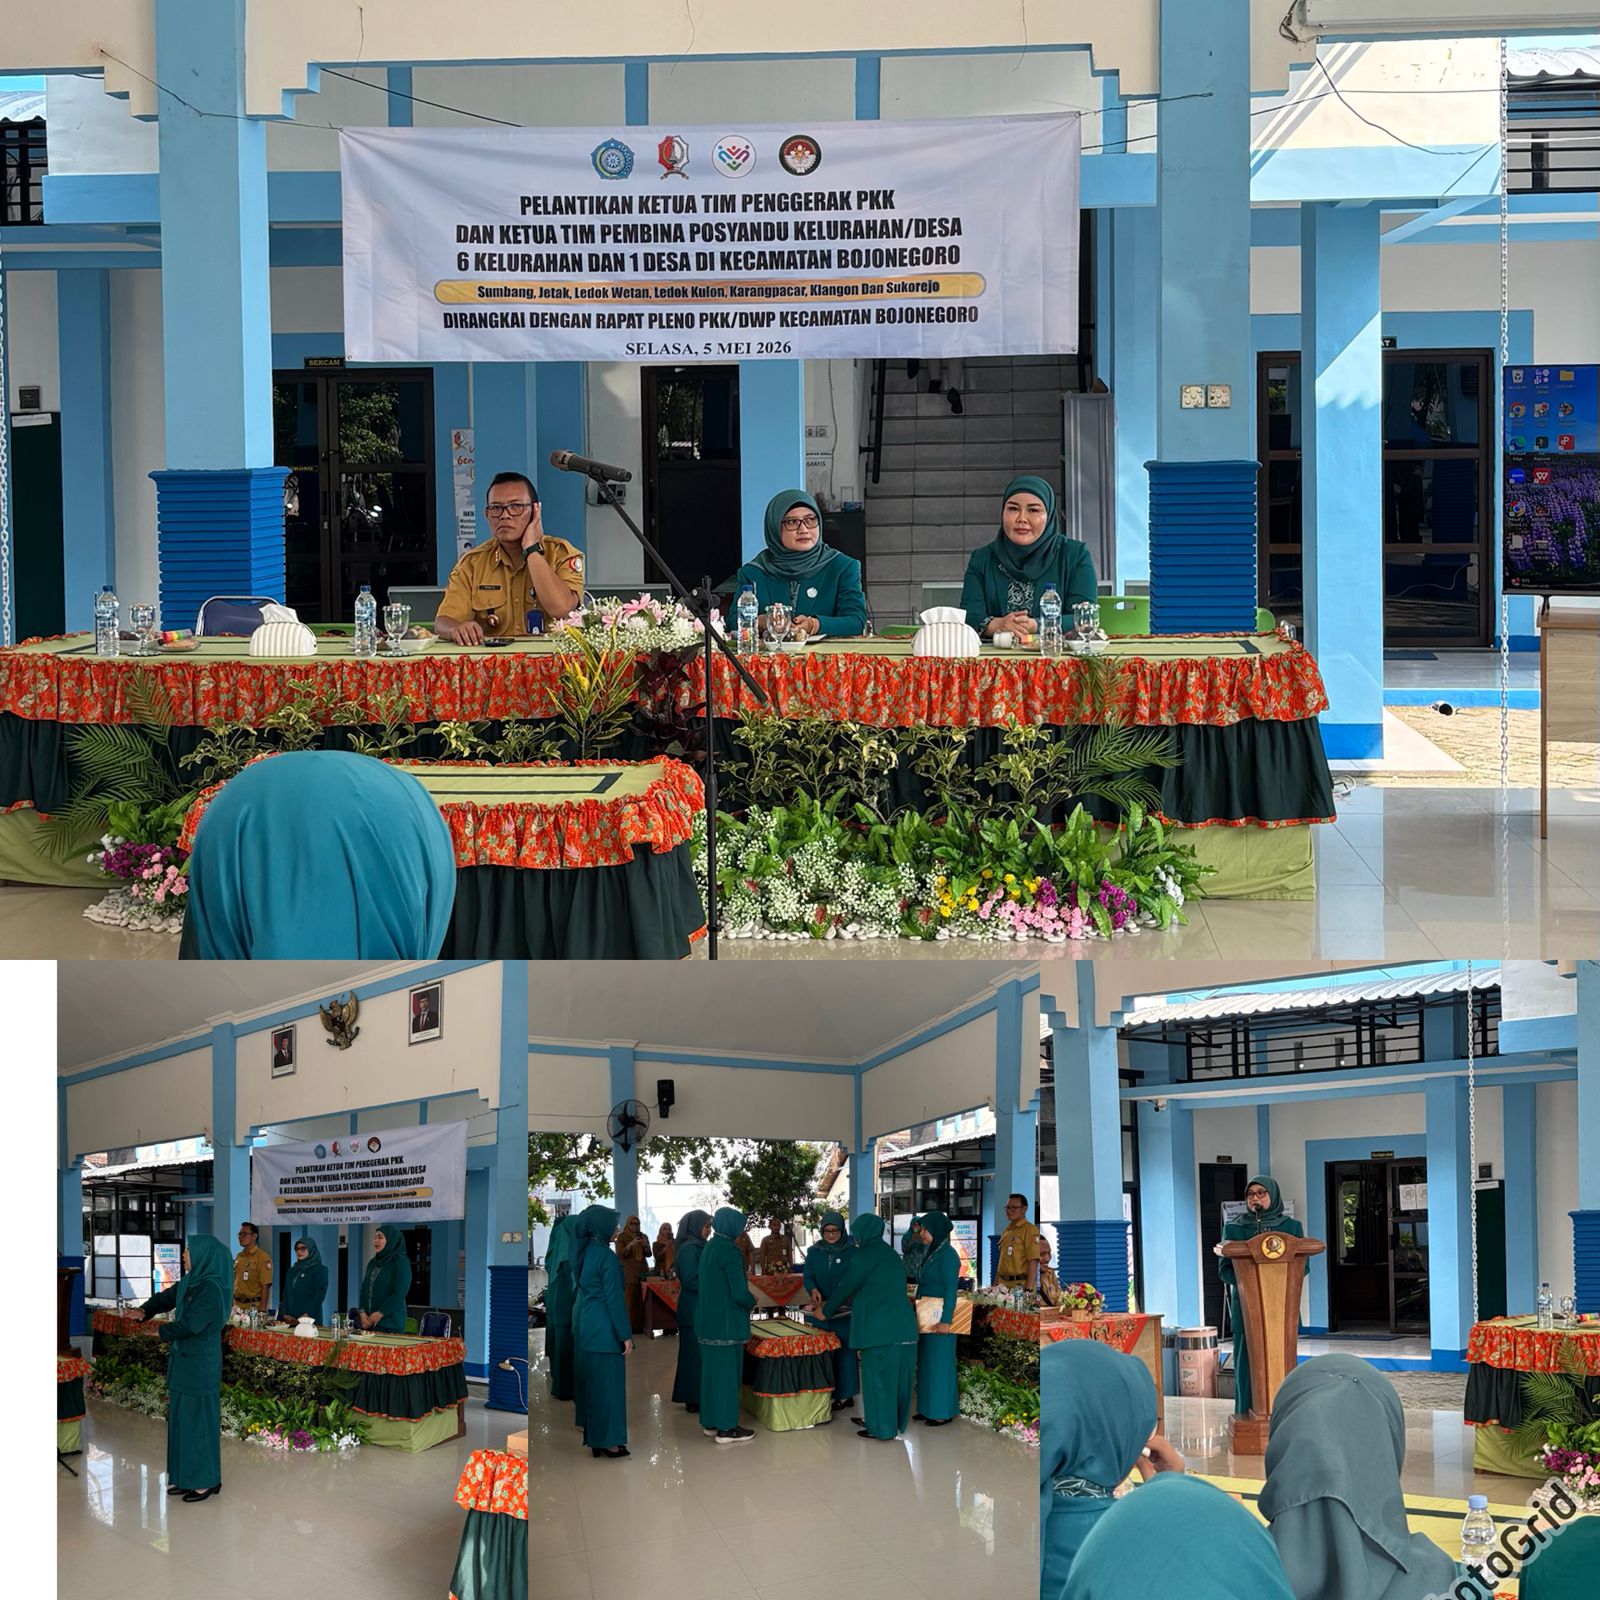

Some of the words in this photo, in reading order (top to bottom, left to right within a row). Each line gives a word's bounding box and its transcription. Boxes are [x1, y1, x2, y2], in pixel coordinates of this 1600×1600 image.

[520, 195, 632, 215] PELANTIKAN
[638, 194, 697, 214] KETUA
[702, 194, 735, 213] TIM
[742, 190, 852, 212] PENGGERAK
[856, 190, 895, 210] PKK
[456, 224, 494, 244] DAN
[500, 224, 556, 244] KETUA
[561, 224, 595, 244] TIM
[601, 223, 686, 244] PEMBINA
[690, 222, 788, 243] POSYANDU
[794, 218, 962, 241] KELURAHAN/DESA
[457, 252, 468, 271] 6
[474, 252, 583, 272] KELURAHAN
[588, 252, 626, 272] DAN
[630, 252, 638, 272] 1
[644, 252, 691, 272] DESA
[696, 252, 715, 272] DI
[720, 249, 832, 271] KECAMATAN
[837, 245, 960, 269] BOJONEGORO
[478, 286, 536, 300] Sumbang,
[538, 286, 572, 300] Jetak,
[575, 286, 610, 299] Ledok
[612, 286, 652, 300] Wetan,
[654, 286, 688, 299] Ledok
[691, 286, 728, 300] Kulon,
[730, 284, 808, 300] Karangpacar,
[810, 284, 860, 298] Klangon
[862, 282, 884, 294] Dan
[886, 280, 940, 295] Sukorejo
[443, 312, 526, 328] DIRANGKAI
[530, 312, 592, 328] DENGAN
[596, 312, 644, 328] RAPAT
[648, 312, 695, 328] PLENO
[700, 310, 776, 329] PKK/DWP
[780, 308, 871, 328] KECAMATAN
[876, 306, 978, 326] BOJONEGORO
[626, 342, 698, 356] SELASA,
[703, 342, 712, 354] 5
[716, 342, 751, 354] MEI
[756, 341, 792, 354] 2026
